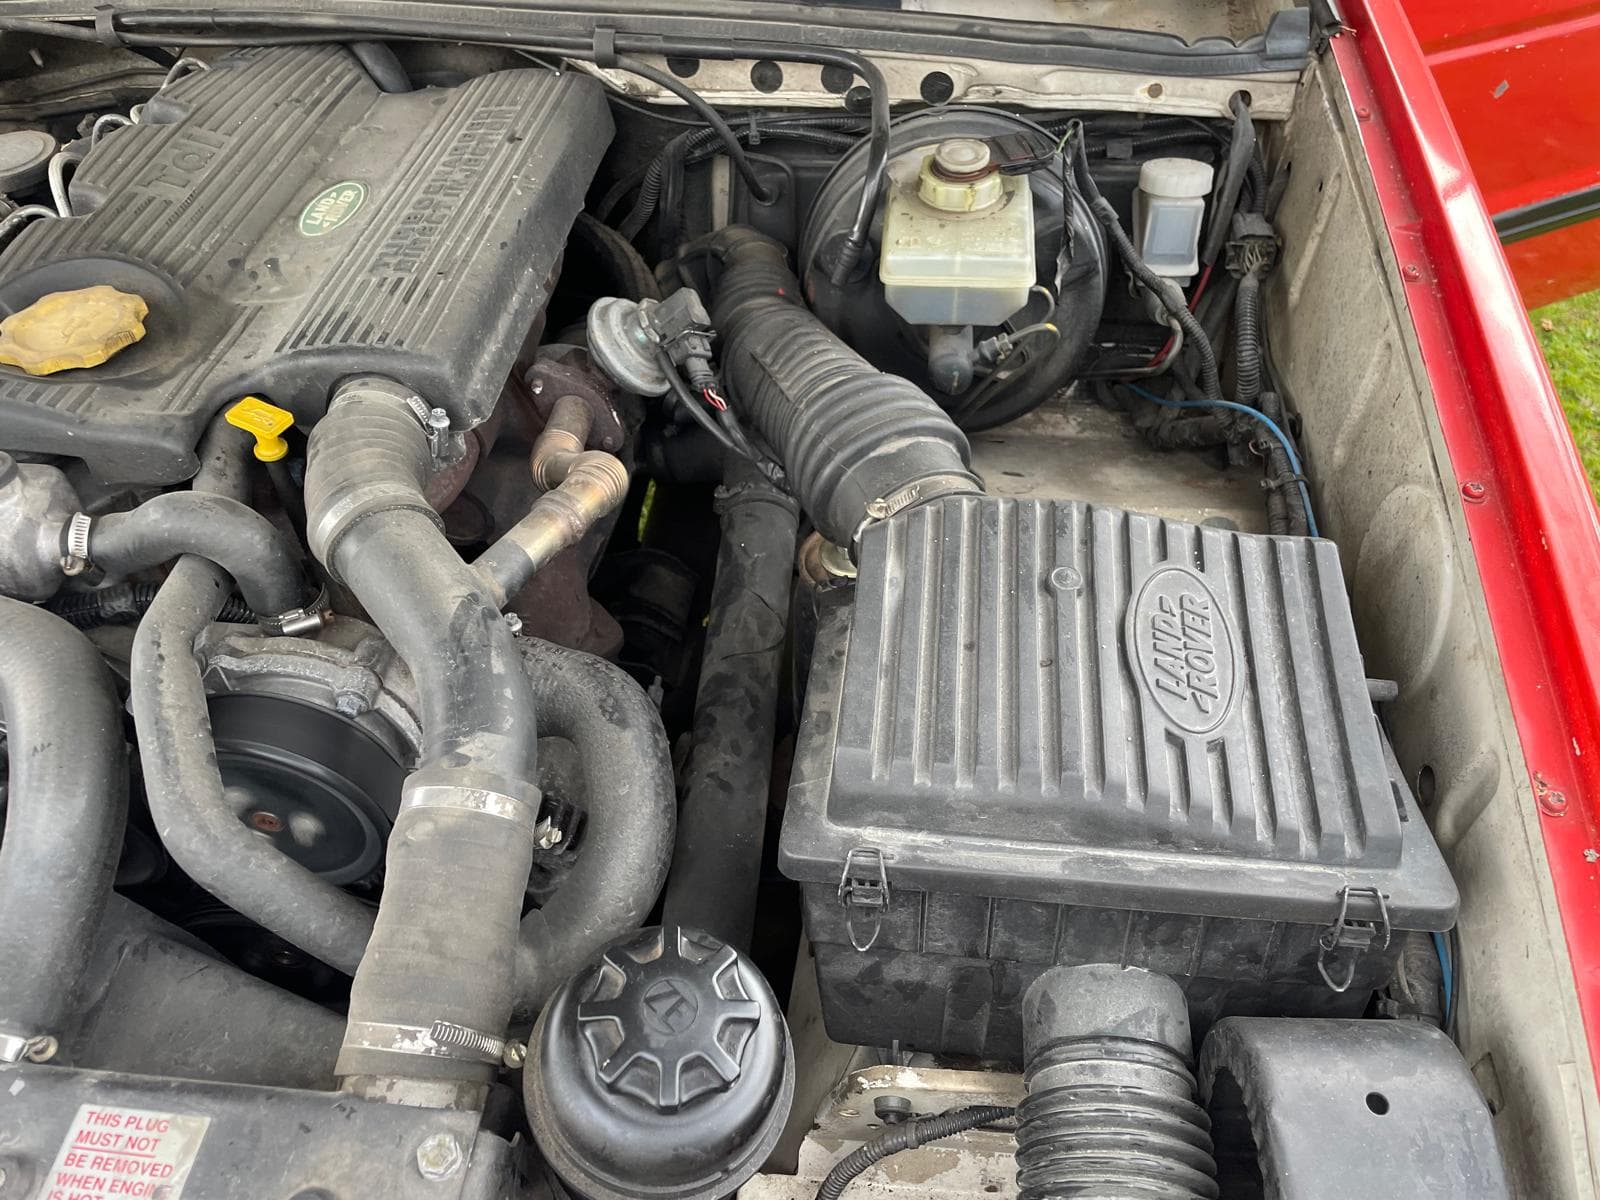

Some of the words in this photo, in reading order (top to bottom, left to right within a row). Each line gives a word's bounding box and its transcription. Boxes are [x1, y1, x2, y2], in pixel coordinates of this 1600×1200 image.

[368, 111, 491, 273] TURBOCHARGED
[306, 197, 336, 225] LAND
[1152, 613, 1187, 701] LAND
[1179, 593, 1219, 700] ROVER
[86, 1111, 122, 1128] THIS
[124, 1116, 170, 1133] PLUG
[75, 1130, 124, 1147] MUST
[125, 1136, 161, 1152] NOT
[63, 1152, 88, 1168] BE
[90, 1156, 174, 1178] REMOVED
[55, 1172, 106, 1191] WHEN
[108, 1179, 169, 1198] ENGI
